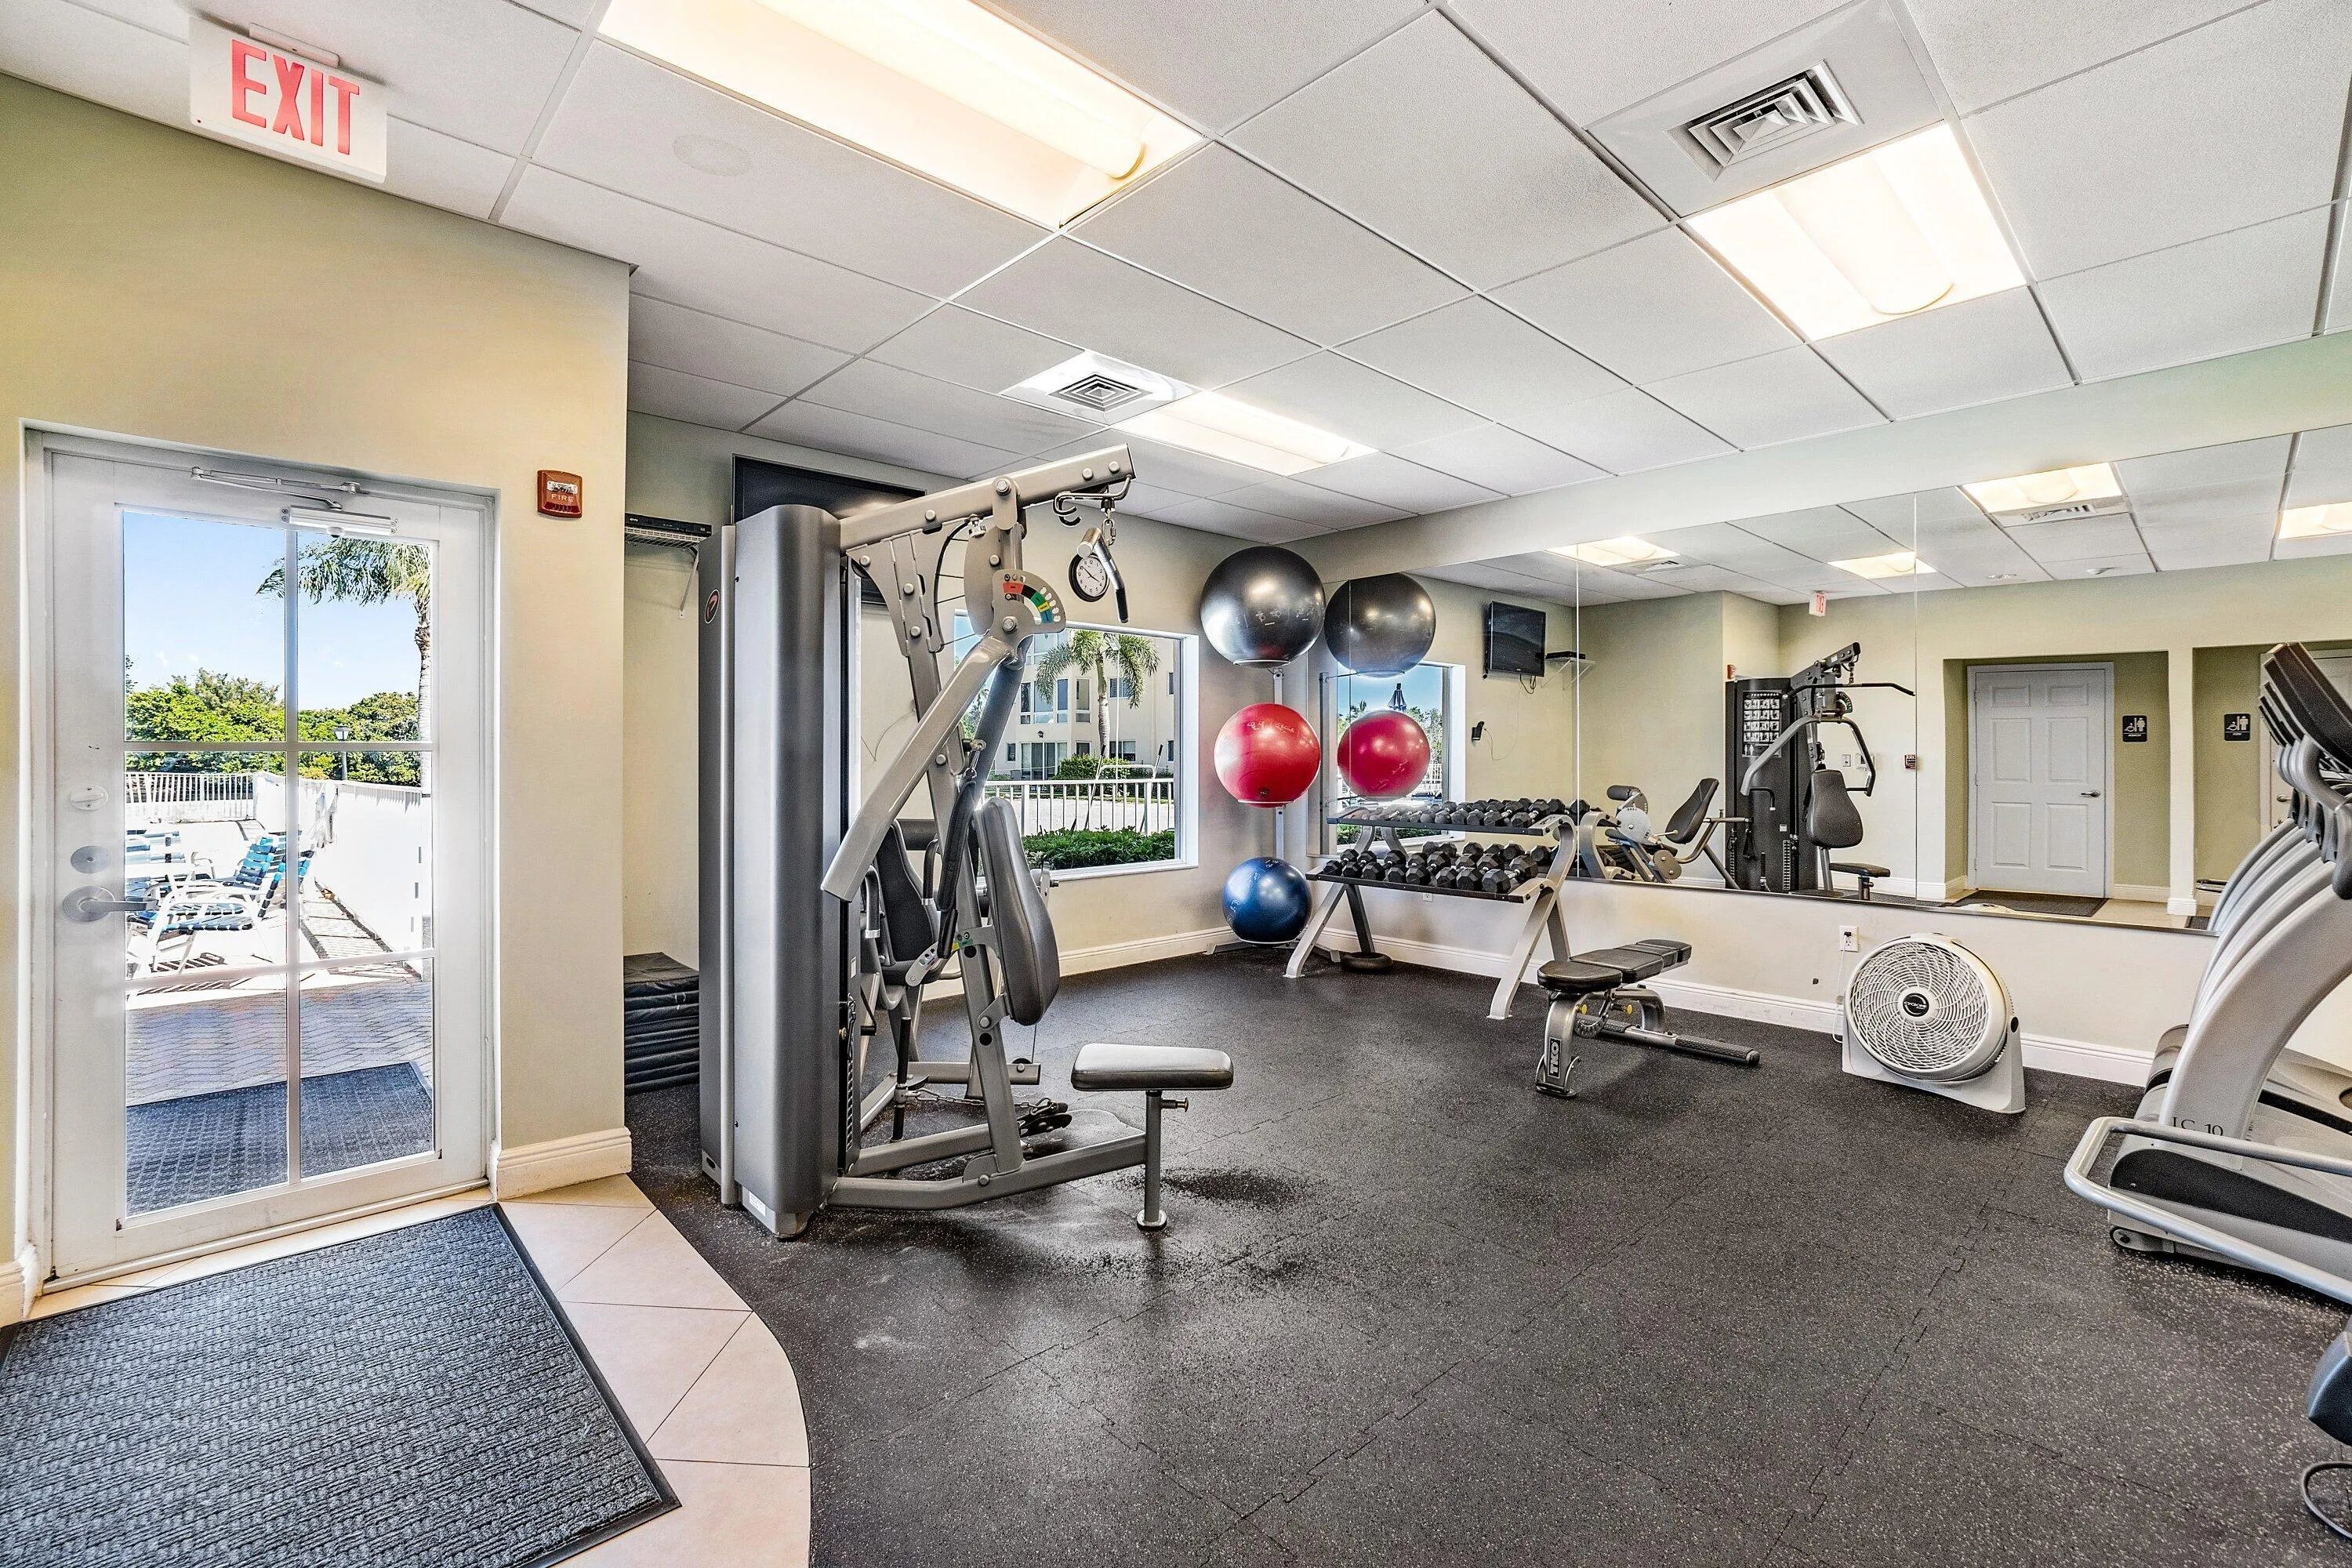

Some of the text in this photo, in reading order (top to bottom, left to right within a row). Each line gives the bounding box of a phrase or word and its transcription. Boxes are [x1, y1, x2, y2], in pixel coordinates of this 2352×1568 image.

[231, 38, 360, 155] EXIT
[551, 493, 574, 503] FIRE
[1550, 1042, 1559, 1074] TKO
